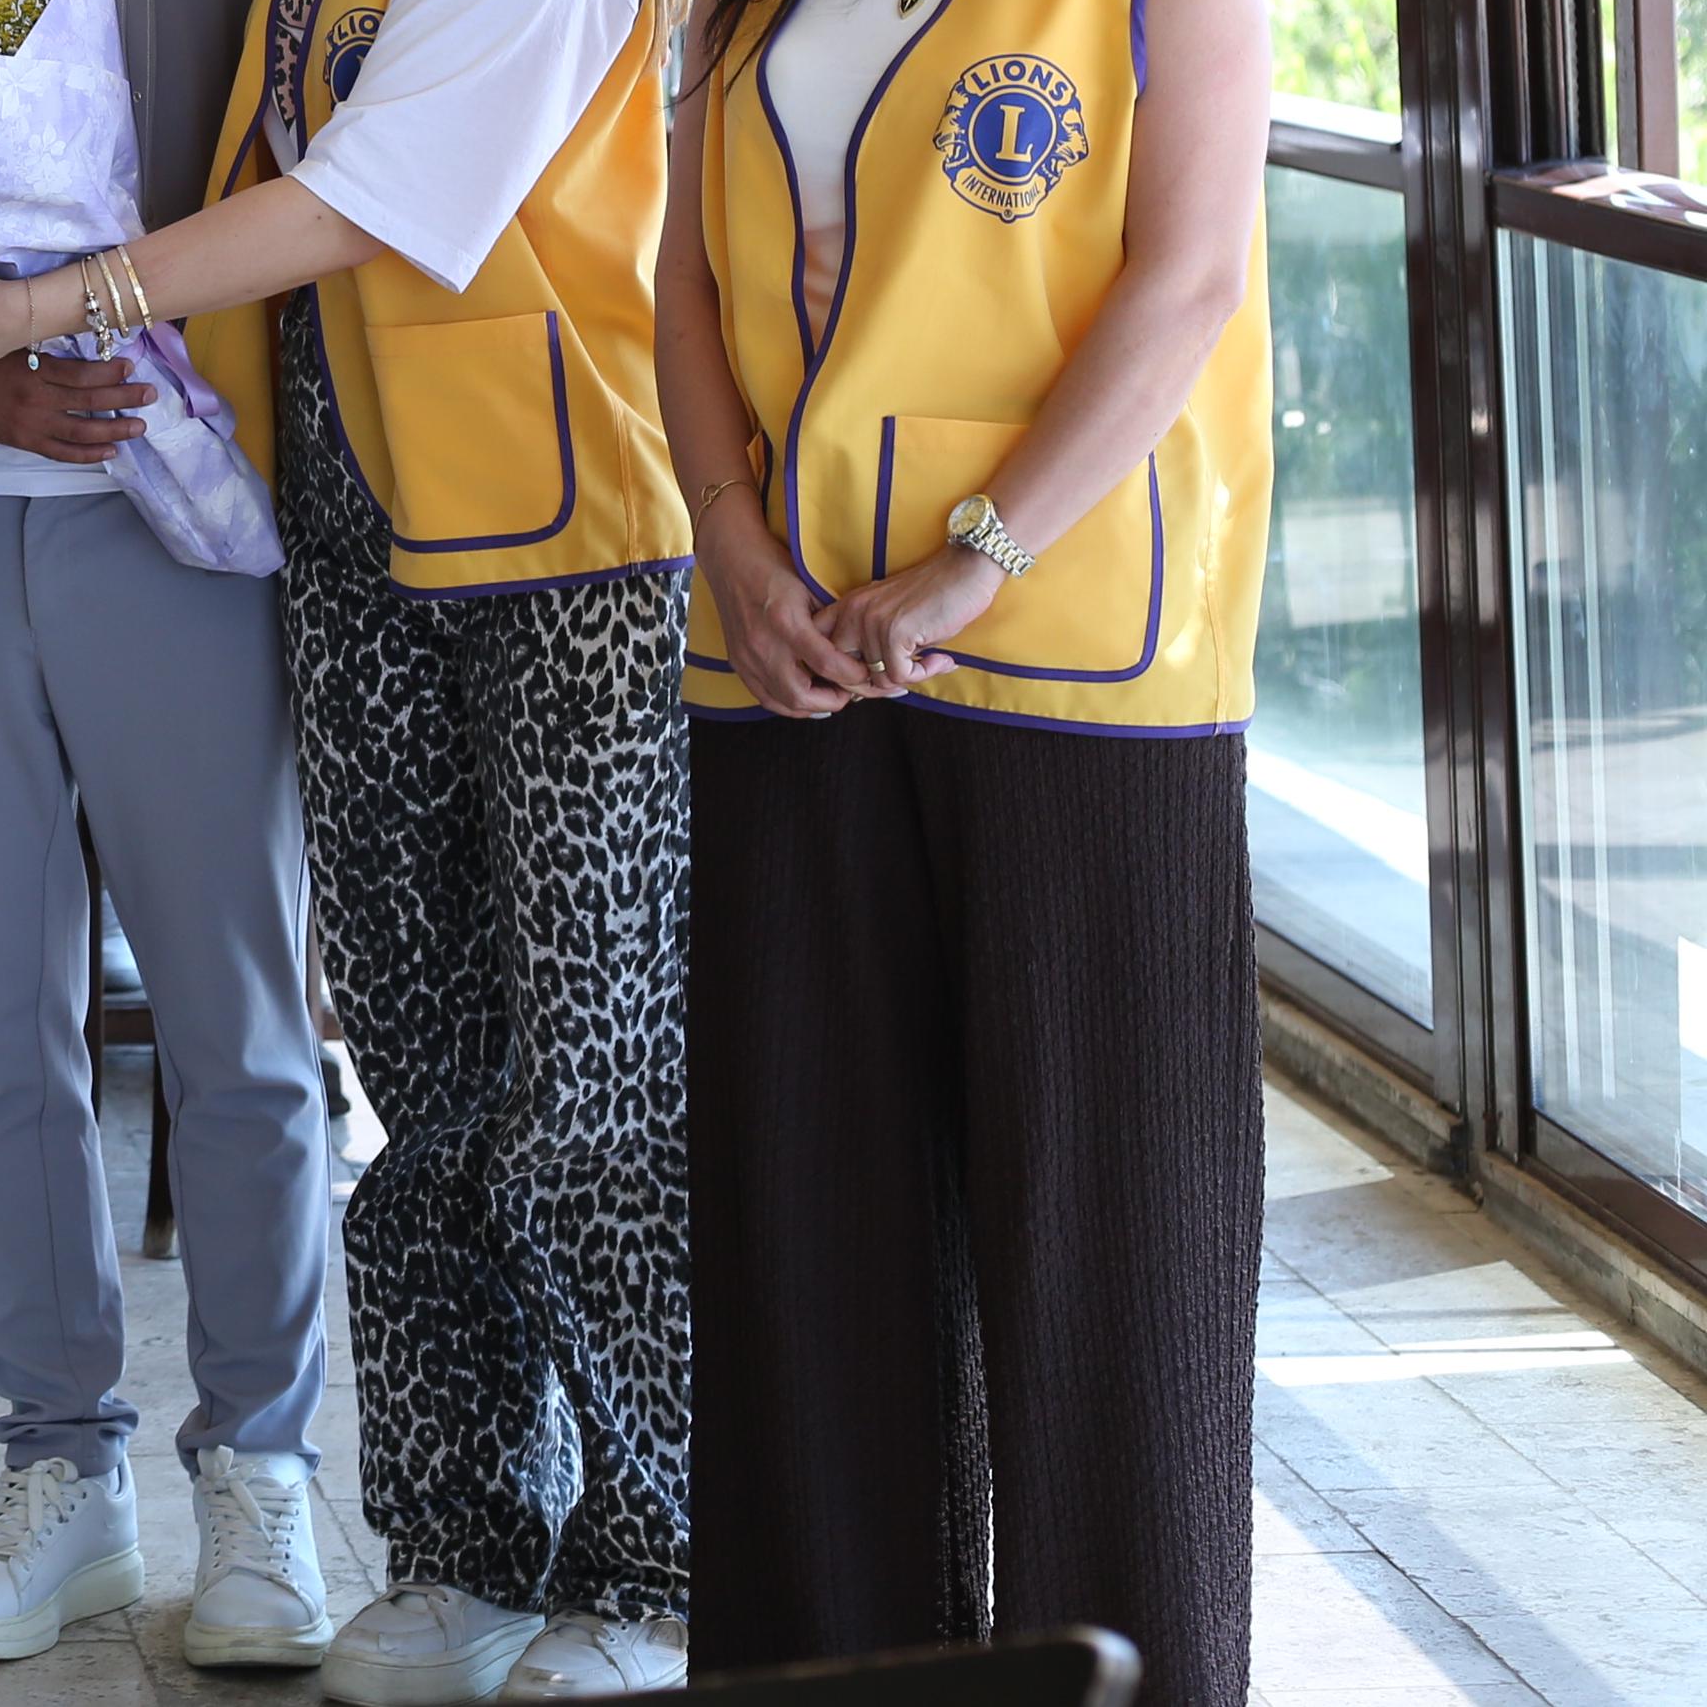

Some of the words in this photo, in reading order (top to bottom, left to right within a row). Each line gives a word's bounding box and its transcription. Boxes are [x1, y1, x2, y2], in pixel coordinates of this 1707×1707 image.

[338, 14, 380, 40] LIO
[971, 59, 1069, 102] LIONS
[995, 104, 1034, 163] L
